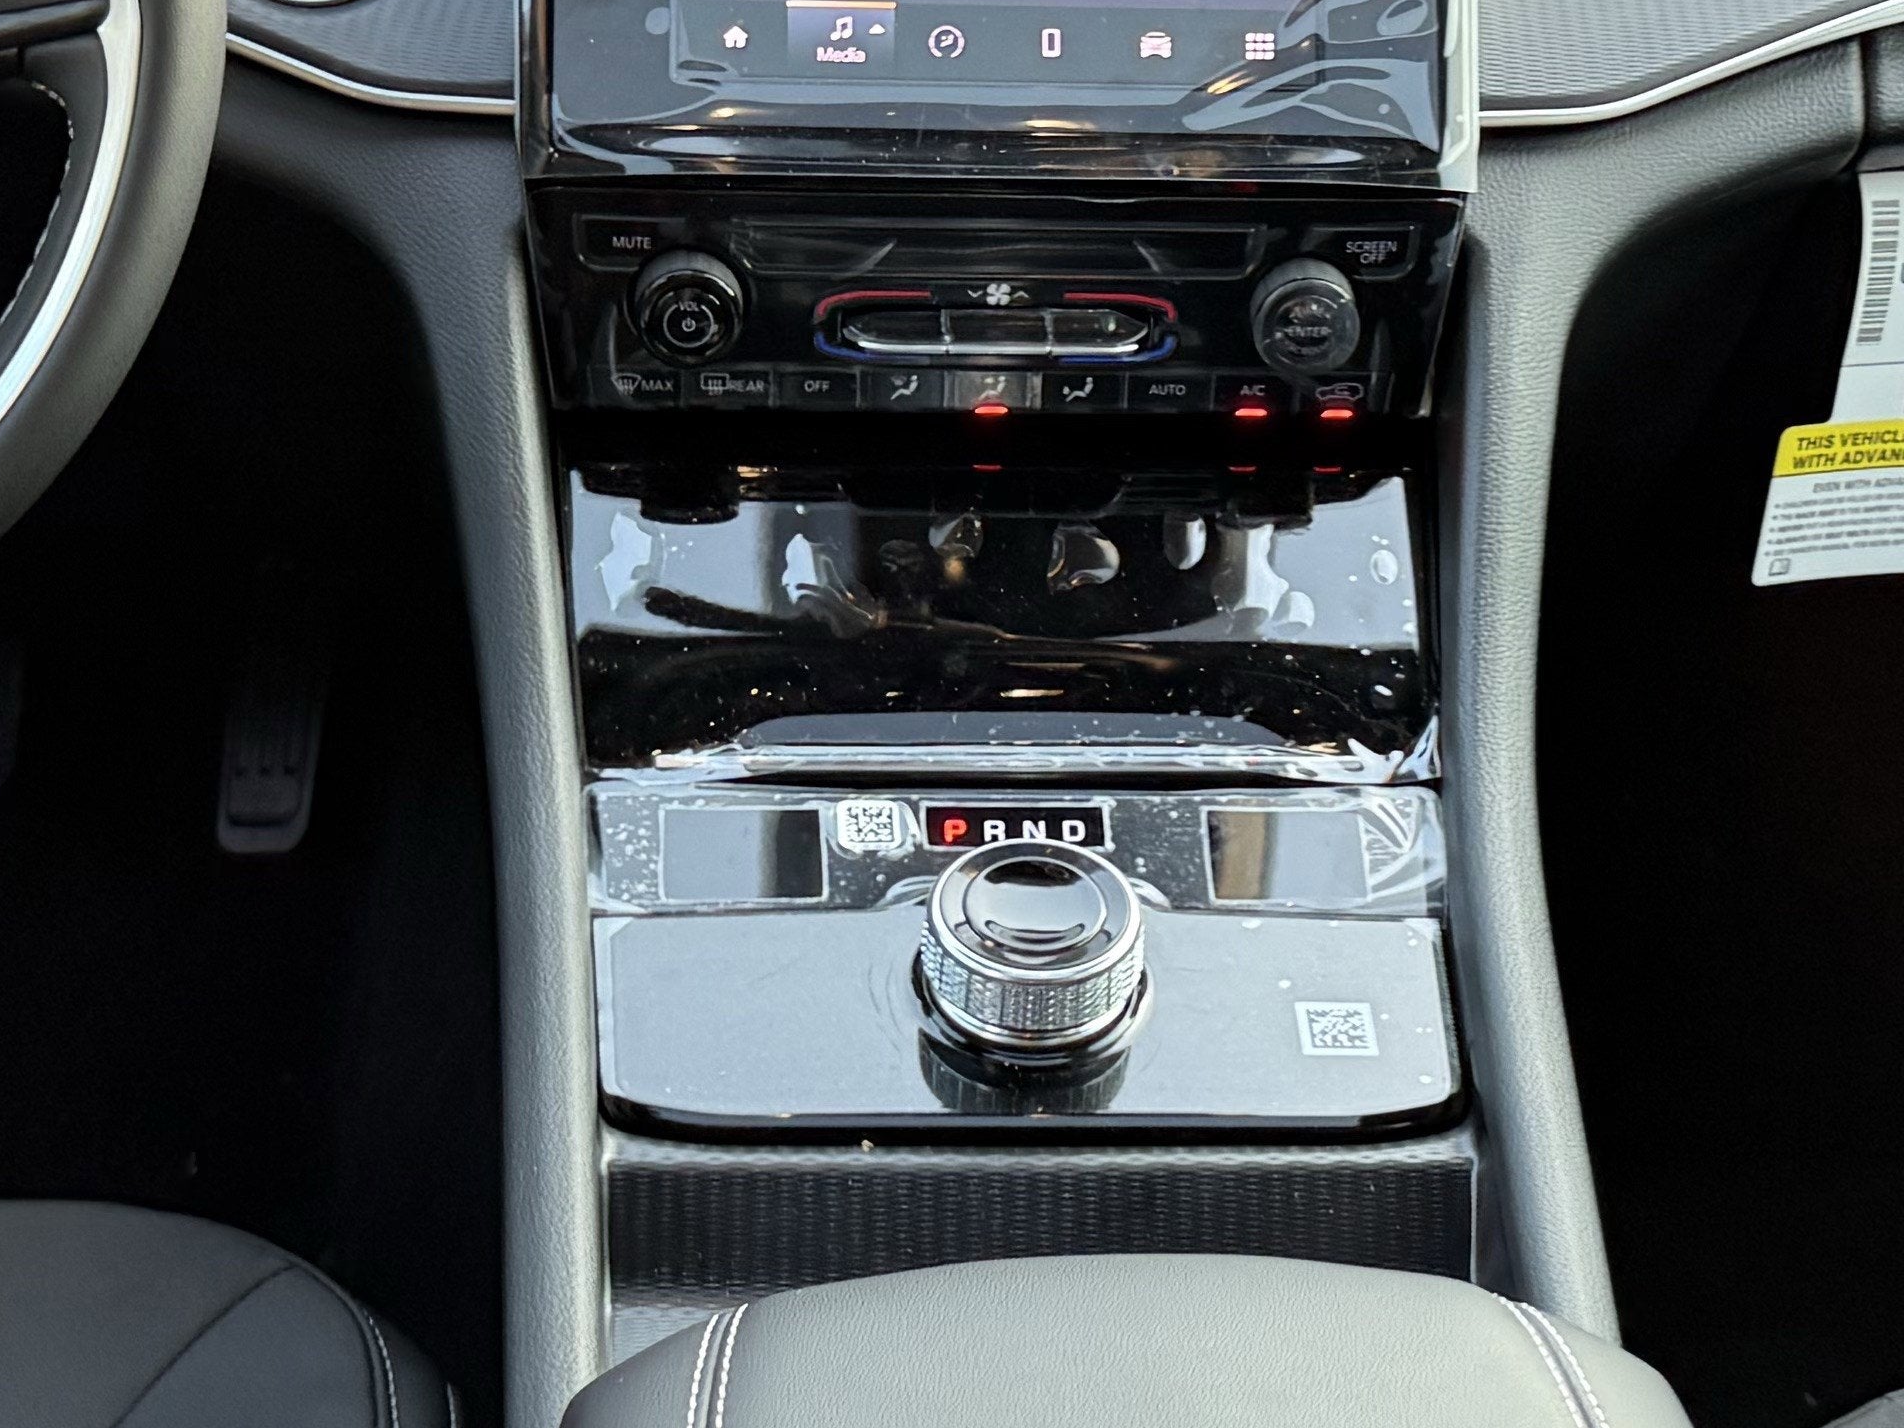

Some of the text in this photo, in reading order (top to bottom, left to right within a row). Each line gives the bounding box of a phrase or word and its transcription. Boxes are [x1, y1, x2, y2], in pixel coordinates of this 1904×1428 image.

[816, 46, 867, 63] Media
[612, 236, 652, 249] MUTE
[1346, 241, 1398, 253] SCREEN
[1359, 253, 1387, 264] OFF
[678, 301, 700, 312] VOL
[641, 379, 674, 392] MAX
[729, 379, 765, 392] REAR
[804, 381, 830, 394] OFF
[1149, 383, 1186, 396] AUTO
[1240, 384, 1266, 396] A/C
[1797, 435, 1836, 452] THIS
[1792, 451, 1838, 469] WITH
[943, 818, 1087, 843] P R N D
